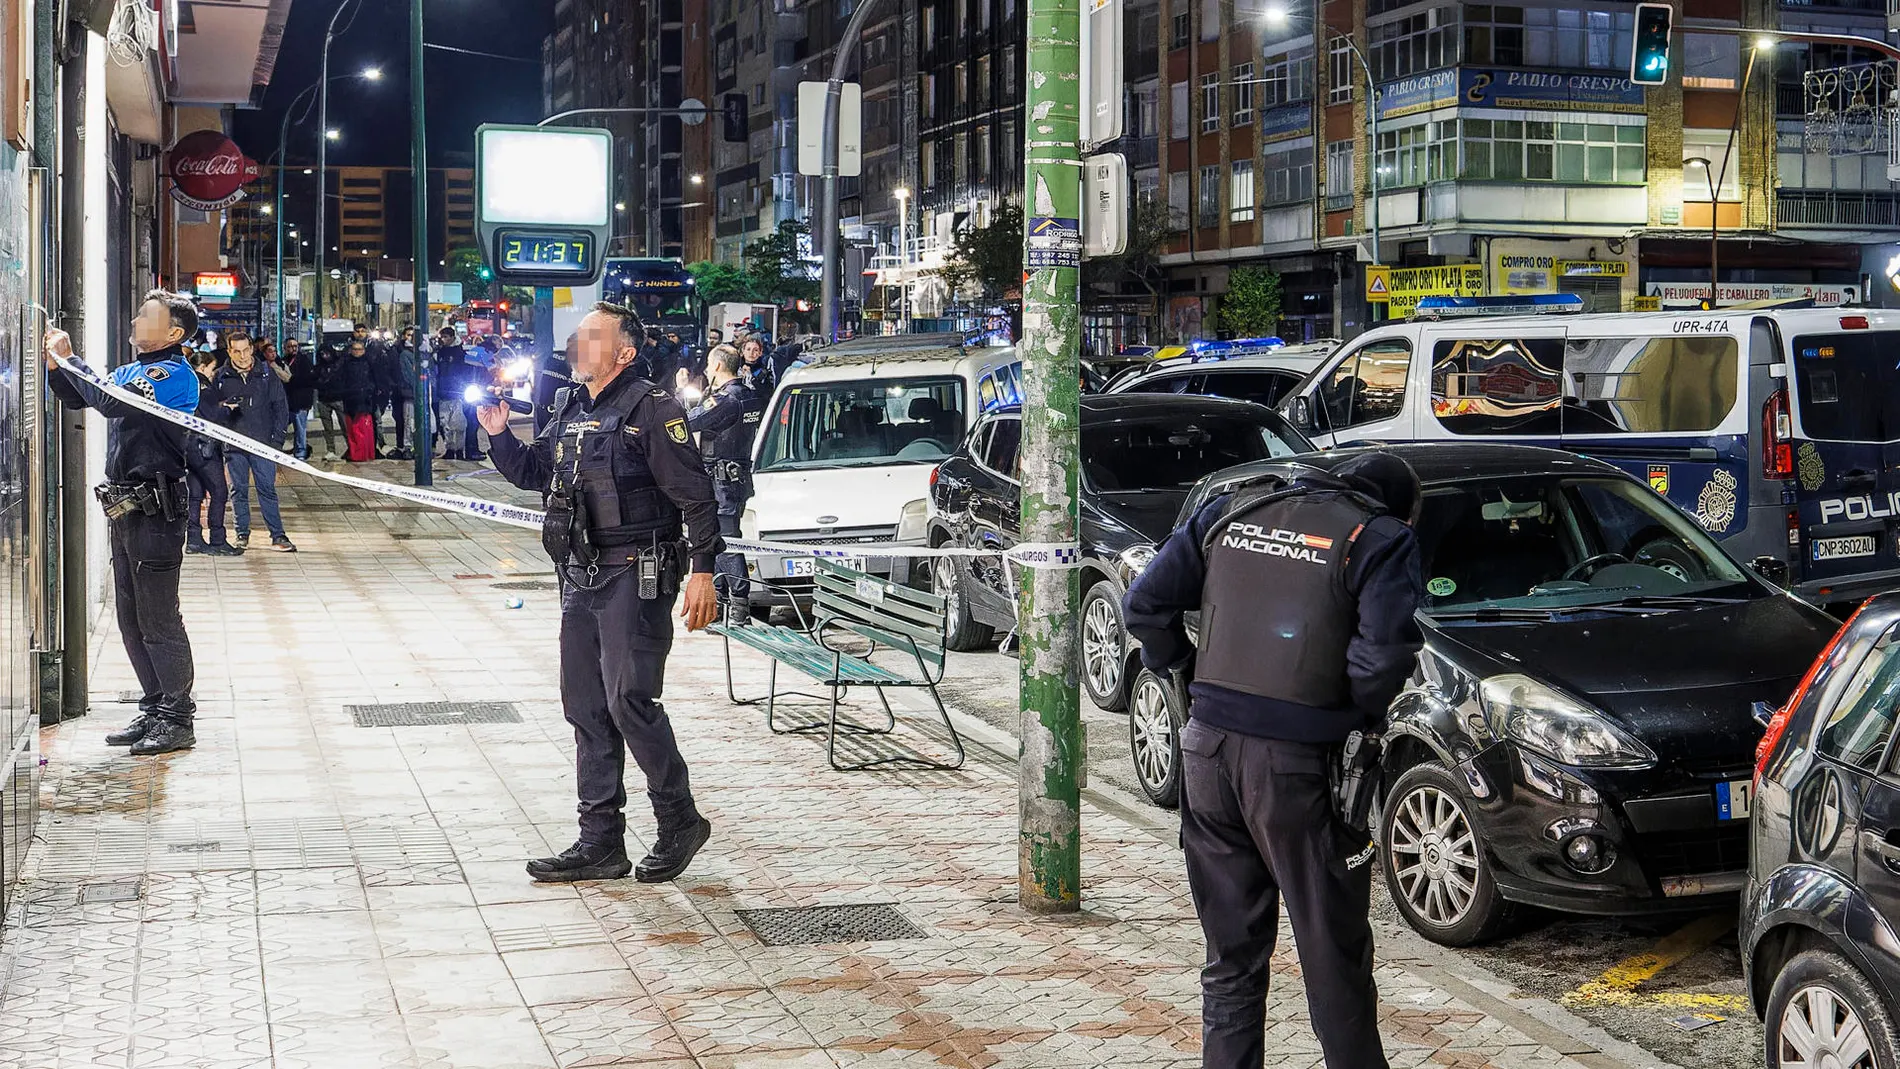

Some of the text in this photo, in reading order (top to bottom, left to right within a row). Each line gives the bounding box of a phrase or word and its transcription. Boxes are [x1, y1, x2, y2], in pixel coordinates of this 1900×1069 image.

[1388, 70, 1454, 97] PABLO CRESPO
[1507, 72, 1632, 92] PABLO CRESPO
[506, 241, 585, 263] 21:37
[1501, 255, 1554, 269] COMPRO ORO
[1390, 270, 1418, 291] COMPRO
[1419, 268, 1433, 290] ORO
[1434, 268, 1440, 288] Y
[1441, 266, 1462, 289] PLATA
[1465, 280, 1482, 289] ORO
[1390, 296, 1408, 306] PAGO
[1409, 295, 1418, 306] EN
[1725, 288, 1770, 300] CABALLERO
[1672, 320, 1729, 333] UPR-47A
[1227, 521, 1307, 546] POLICIA
[1222, 534, 1327, 565] NACIONAL
